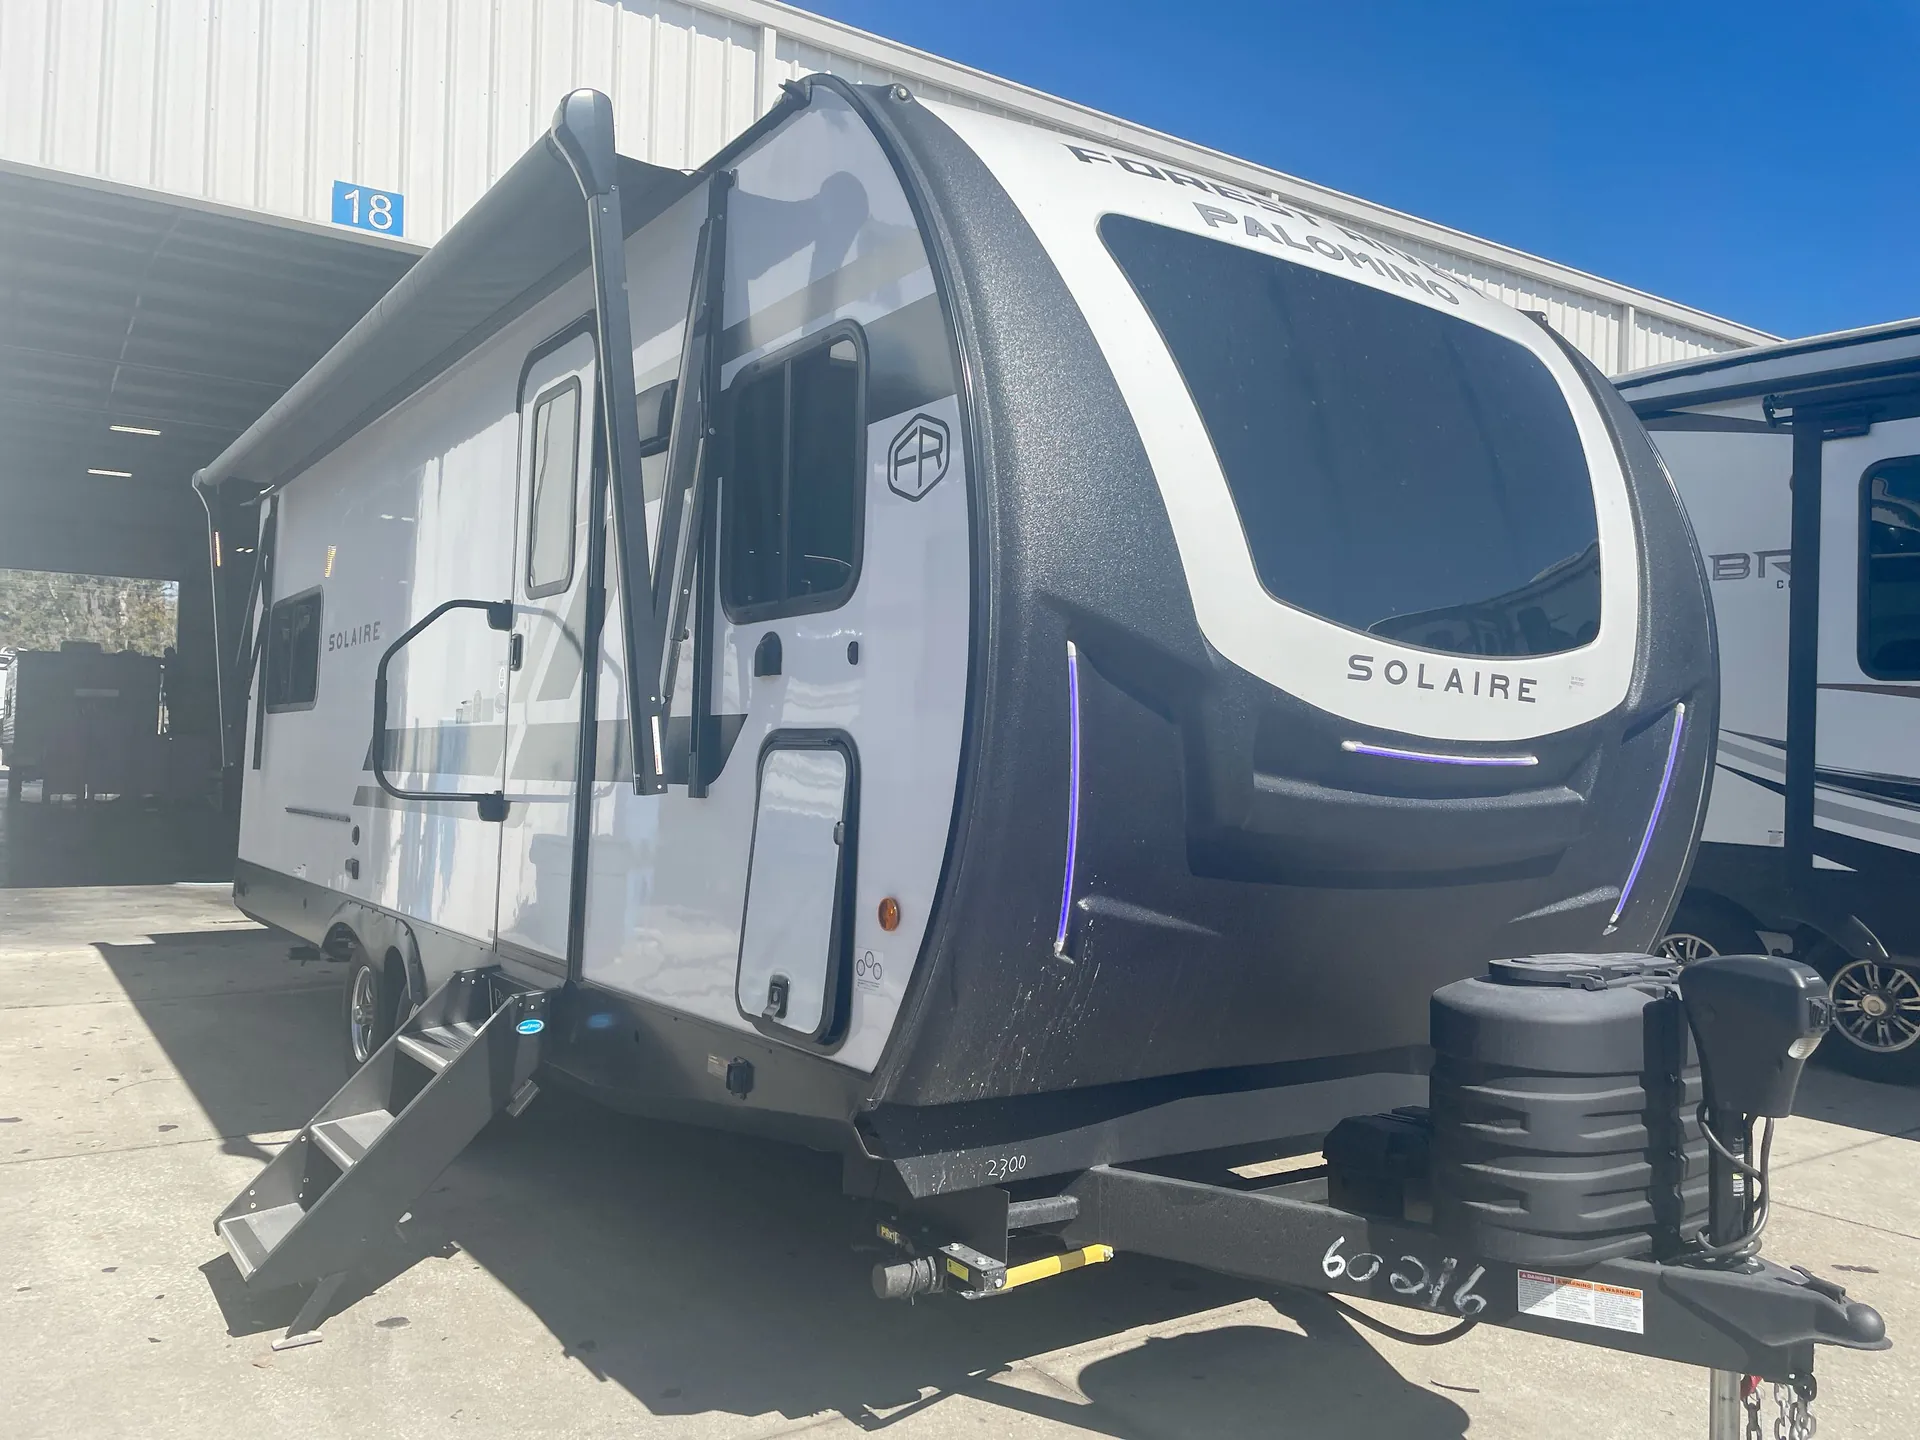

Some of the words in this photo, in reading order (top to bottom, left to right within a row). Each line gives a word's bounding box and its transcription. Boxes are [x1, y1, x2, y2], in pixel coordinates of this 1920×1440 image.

[1063, 143, 1321, 228] FOREST
[344, 189, 392, 230] 18
[1193, 202, 1459, 305] PALOMINO
[1708, 548, 1792, 581] BR
[328, 621, 381, 652] SOLAIRE
[1347, 654, 1537, 703] SOLAIRE
[986, 1155, 1026, 1180] 2300
[1606, 1288, 1635, 1296] WARNING
